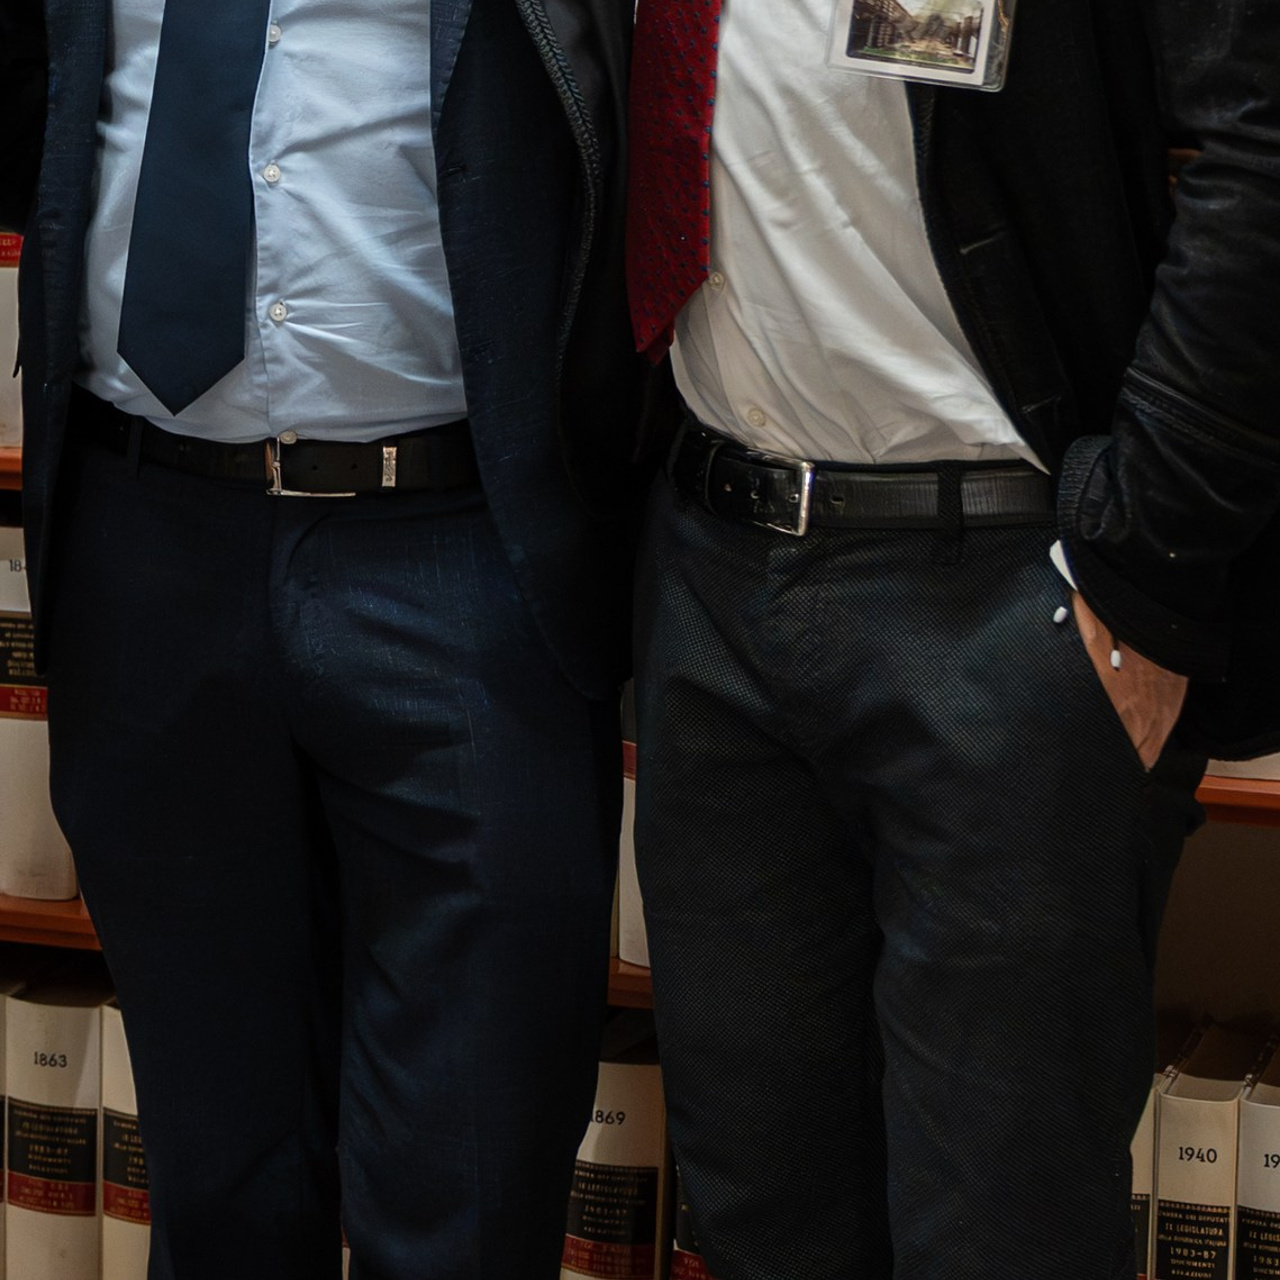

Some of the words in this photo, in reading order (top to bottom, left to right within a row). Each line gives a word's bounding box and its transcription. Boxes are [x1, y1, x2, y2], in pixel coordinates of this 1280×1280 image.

[34, 1051, 68, 1068] 1863
[590, 1109, 626, 1126] 869
[1178, 1146, 1218, 1164] 1940
[1176, 1224, 1224, 1237] LEGISLATURA
[1170, 1246, 1217, 1259] 1983-87
